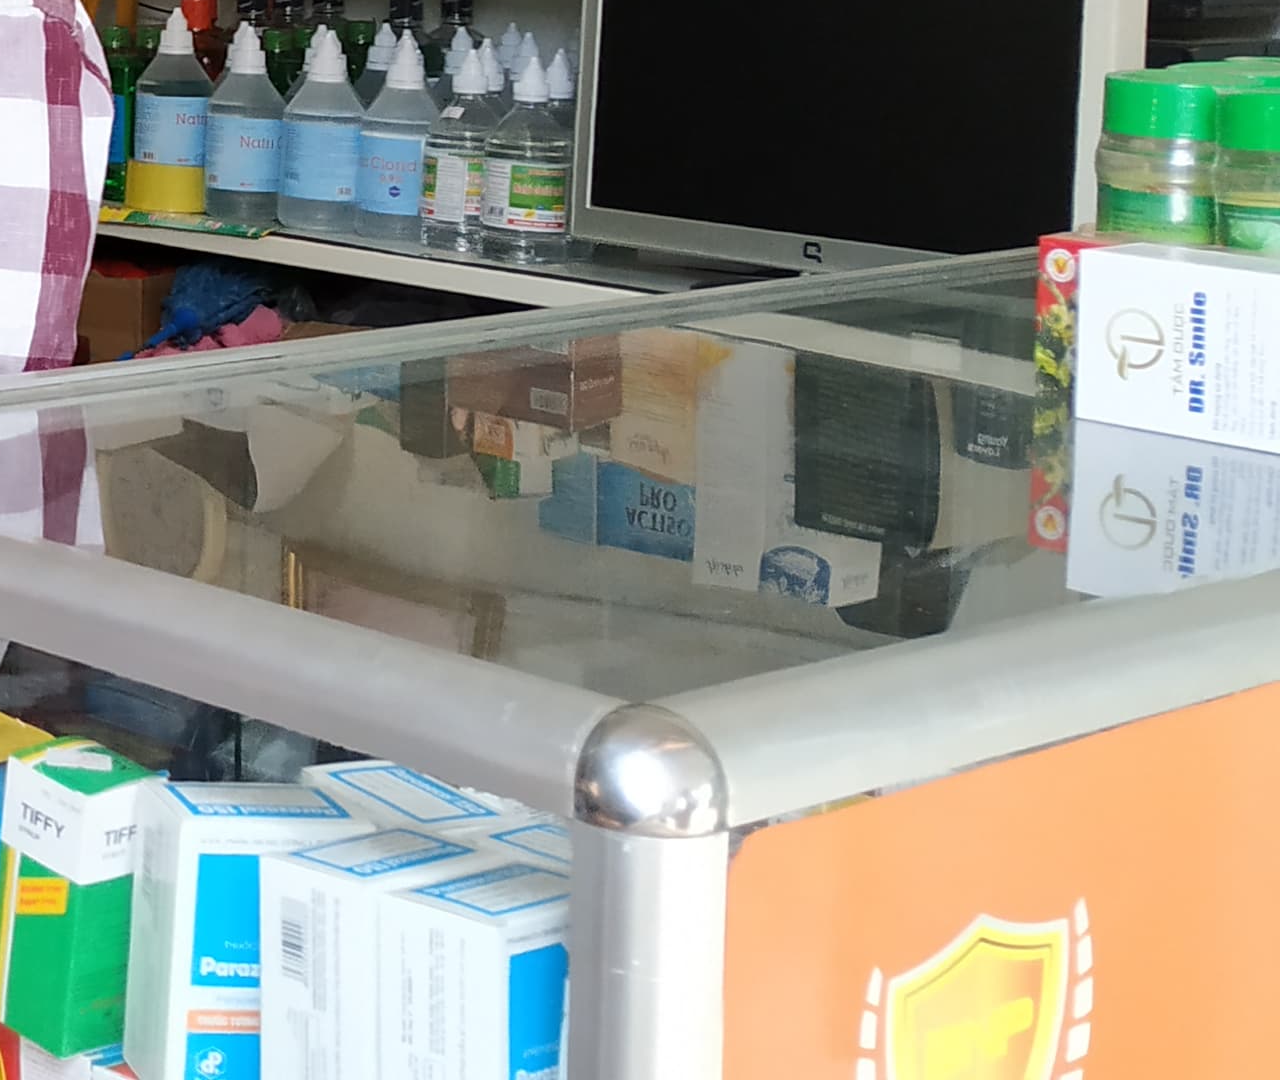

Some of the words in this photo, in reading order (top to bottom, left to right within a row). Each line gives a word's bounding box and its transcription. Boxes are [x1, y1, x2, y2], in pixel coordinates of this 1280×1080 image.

[1187, 291, 1208, 367] Smile
[20, 801, 65, 839] TIFFY
[104, 824, 138, 847] TIFF
[200, 956, 260, 978] Paraz
